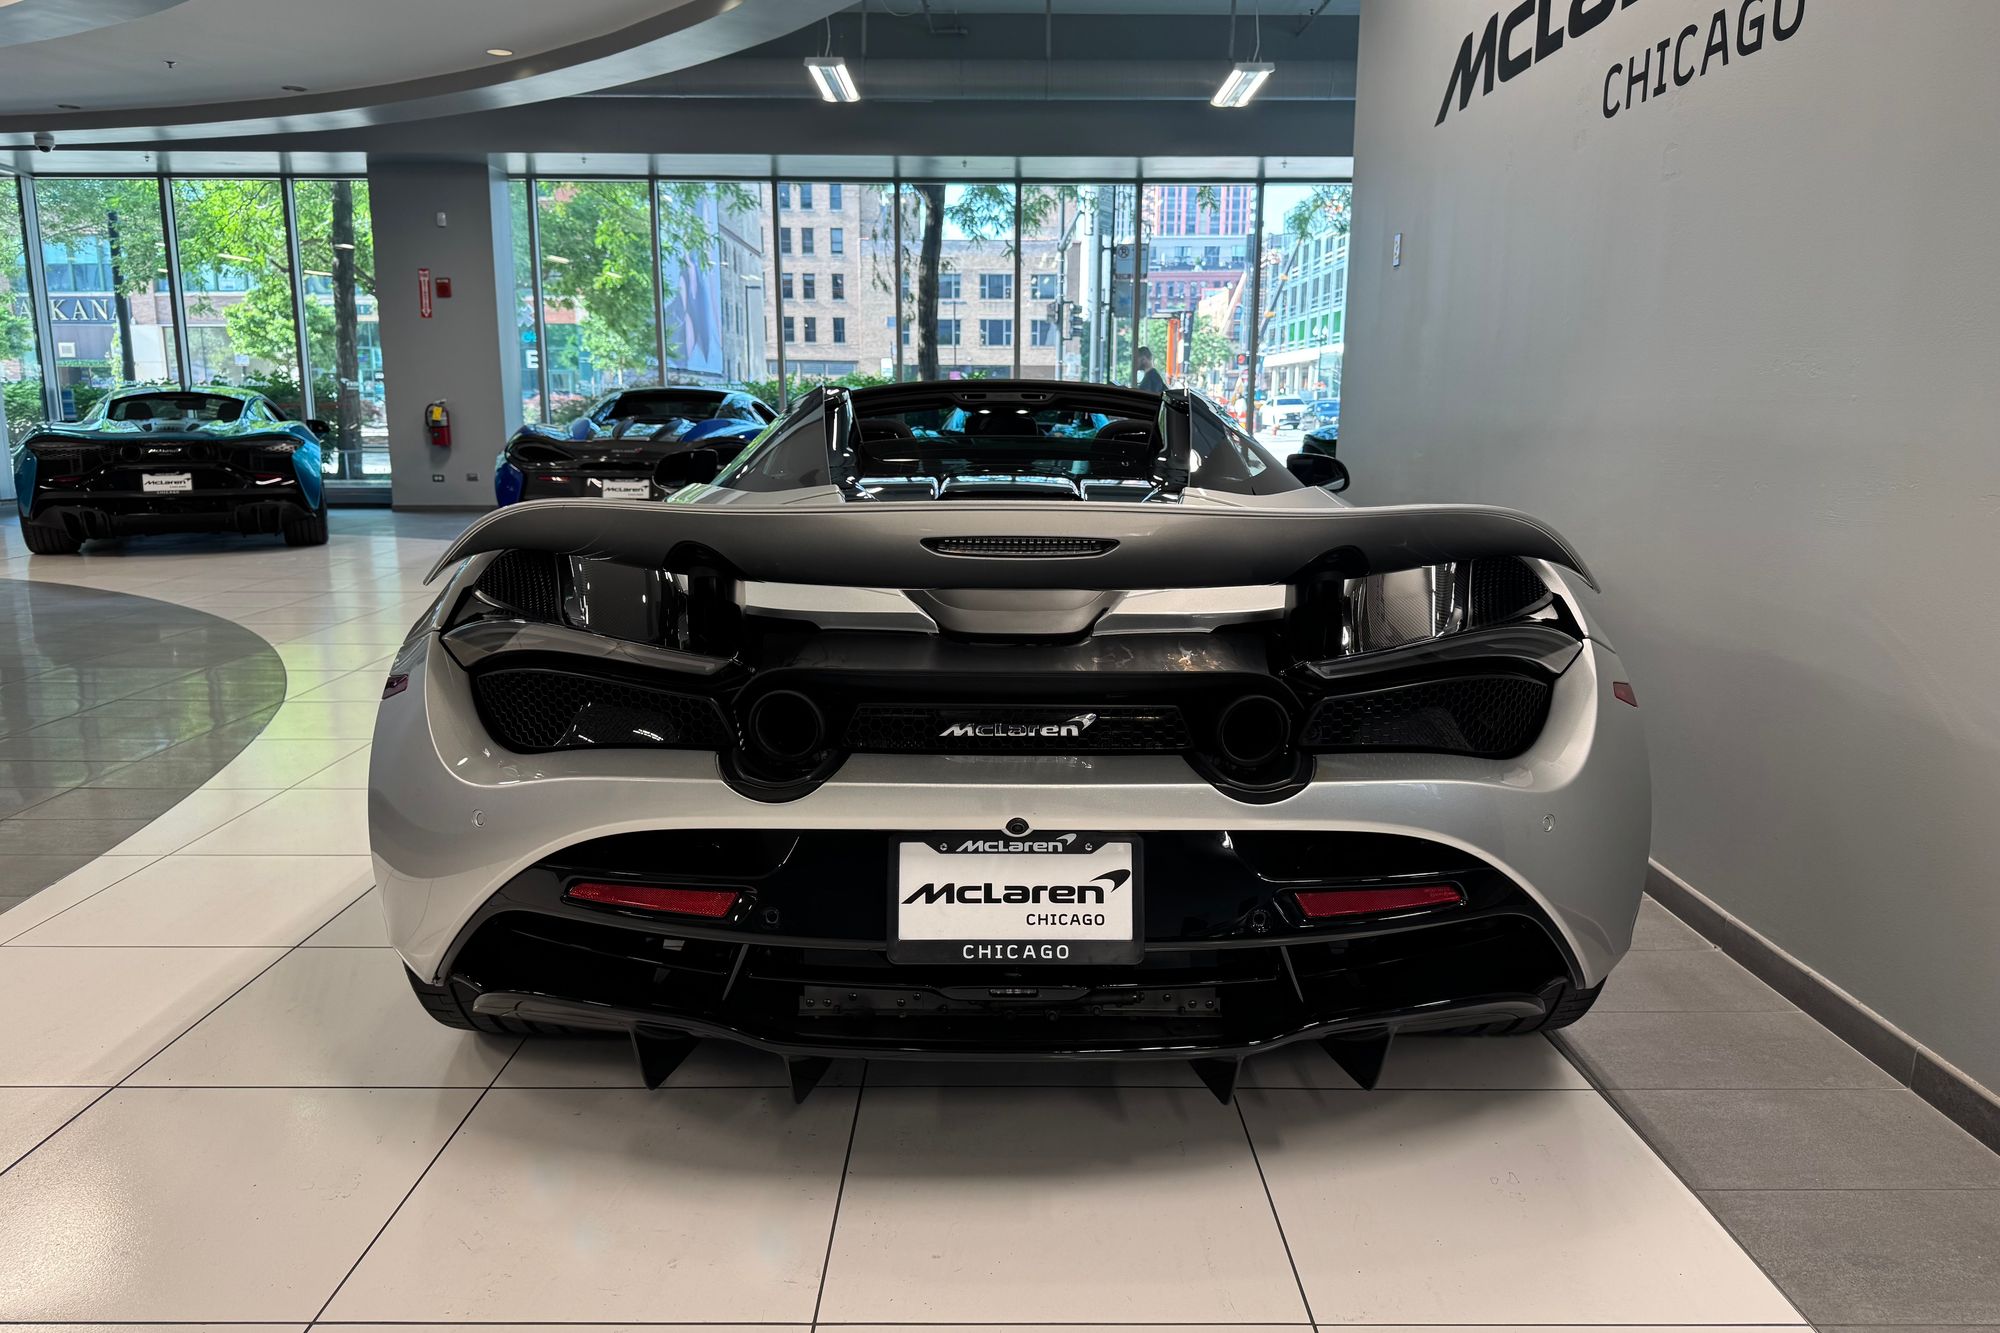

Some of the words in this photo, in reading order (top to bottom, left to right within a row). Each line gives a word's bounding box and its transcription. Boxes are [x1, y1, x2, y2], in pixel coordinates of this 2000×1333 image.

[1603, 0, 1805, 118] CHICAGO
[939, 723, 1079, 737] McLaren
[956, 840, 1063, 852] McLaren
[901, 883, 1105, 904] McLaren
[1026, 913, 1105, 926] CHICAGO
[963, 945, 1069, 959] CHICAGO
